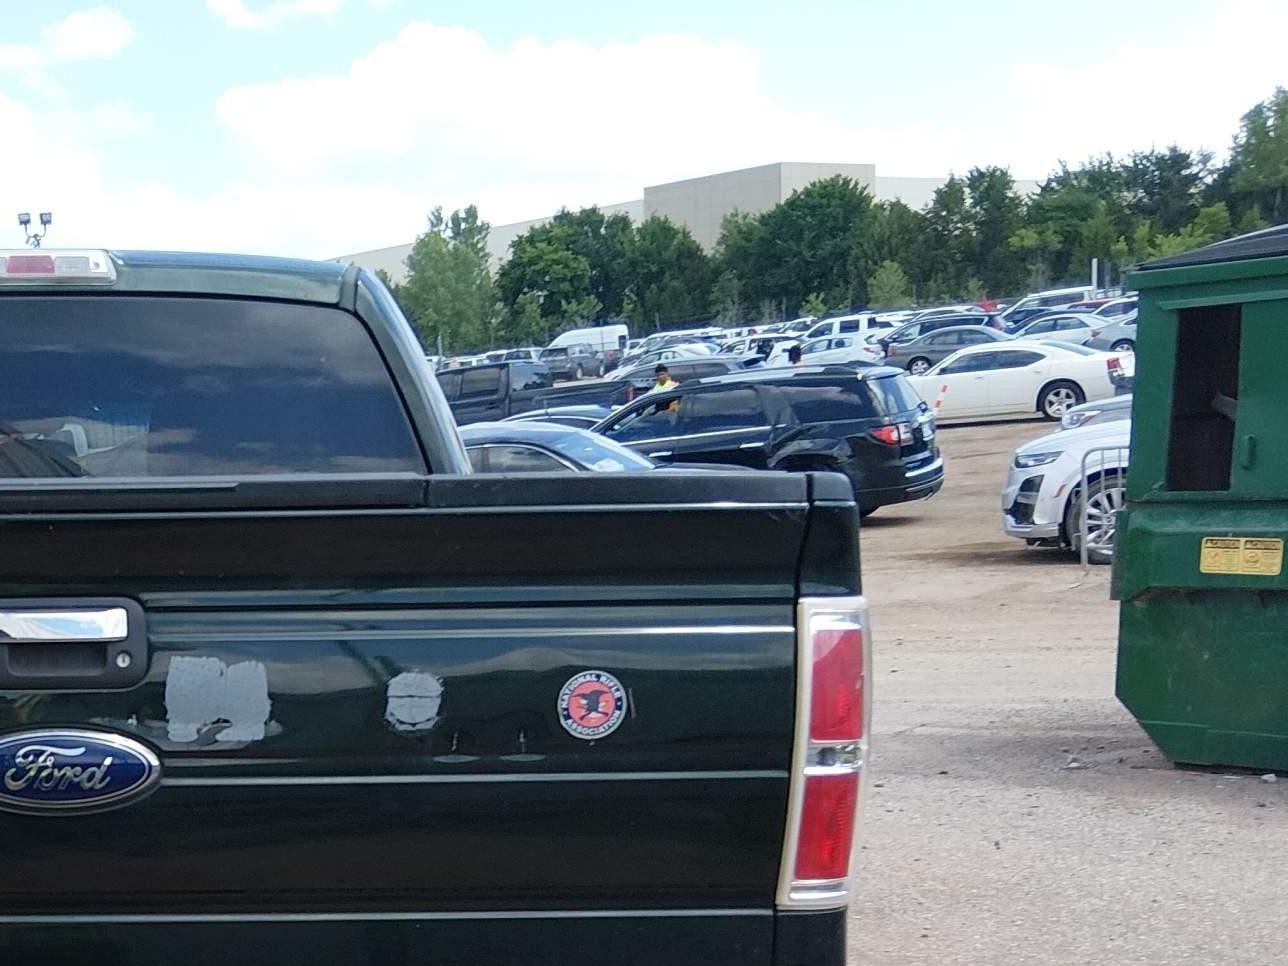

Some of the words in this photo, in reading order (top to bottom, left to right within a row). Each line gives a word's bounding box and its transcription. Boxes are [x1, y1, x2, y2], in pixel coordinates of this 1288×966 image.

[561, 673, 598, 709] NATIONAL
[599, 675, 622, 699] RIFLE
[564, 710, 621, 735] ASSOCIATION
[4, 744, 113, 792] Ford
